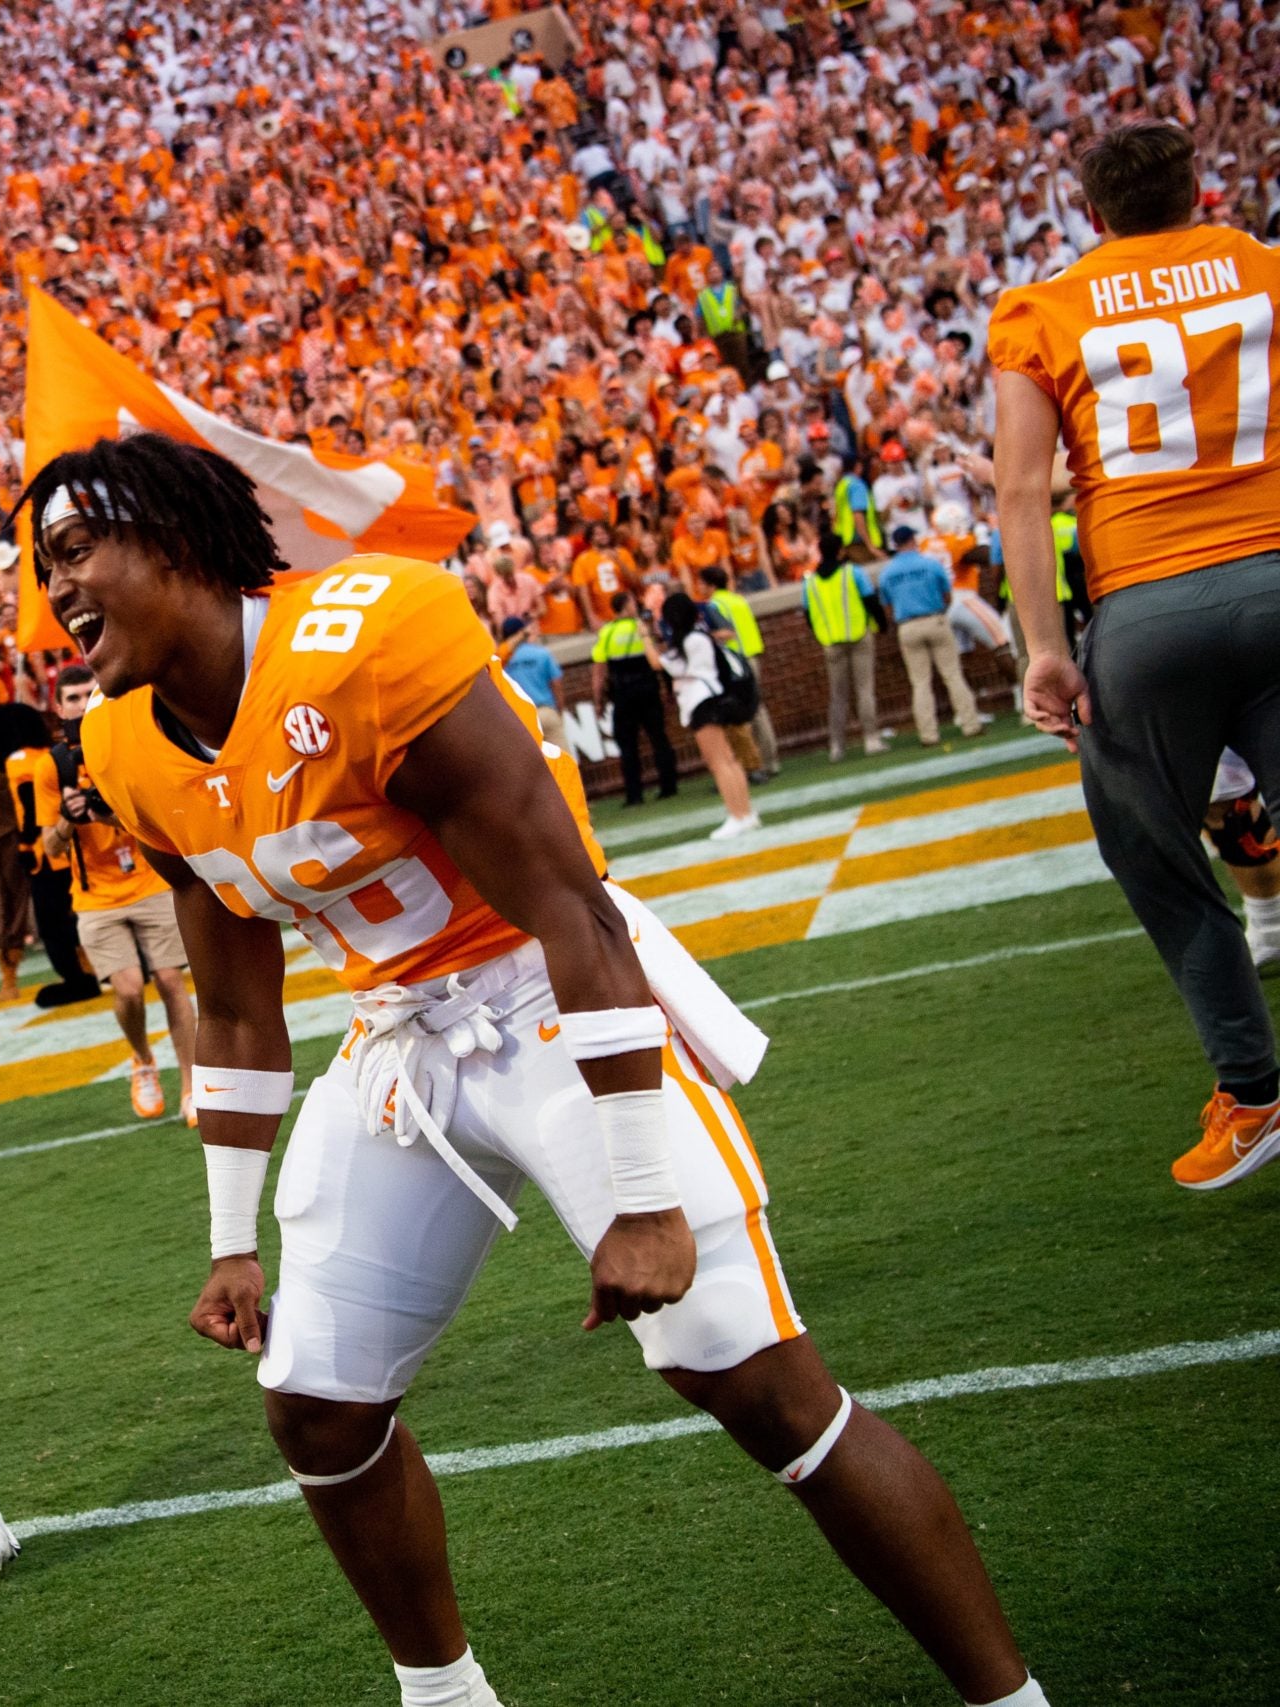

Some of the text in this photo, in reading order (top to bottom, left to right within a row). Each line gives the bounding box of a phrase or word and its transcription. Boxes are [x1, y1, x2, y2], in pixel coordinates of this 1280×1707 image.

[1089, 257, 1241, 318] HELSDON
[1079, 291, 1274, 480] 87
[291, 572, 391, 653] 86
[283, 704, 330, 755] SEC
[205, 774, 231, 808] T
